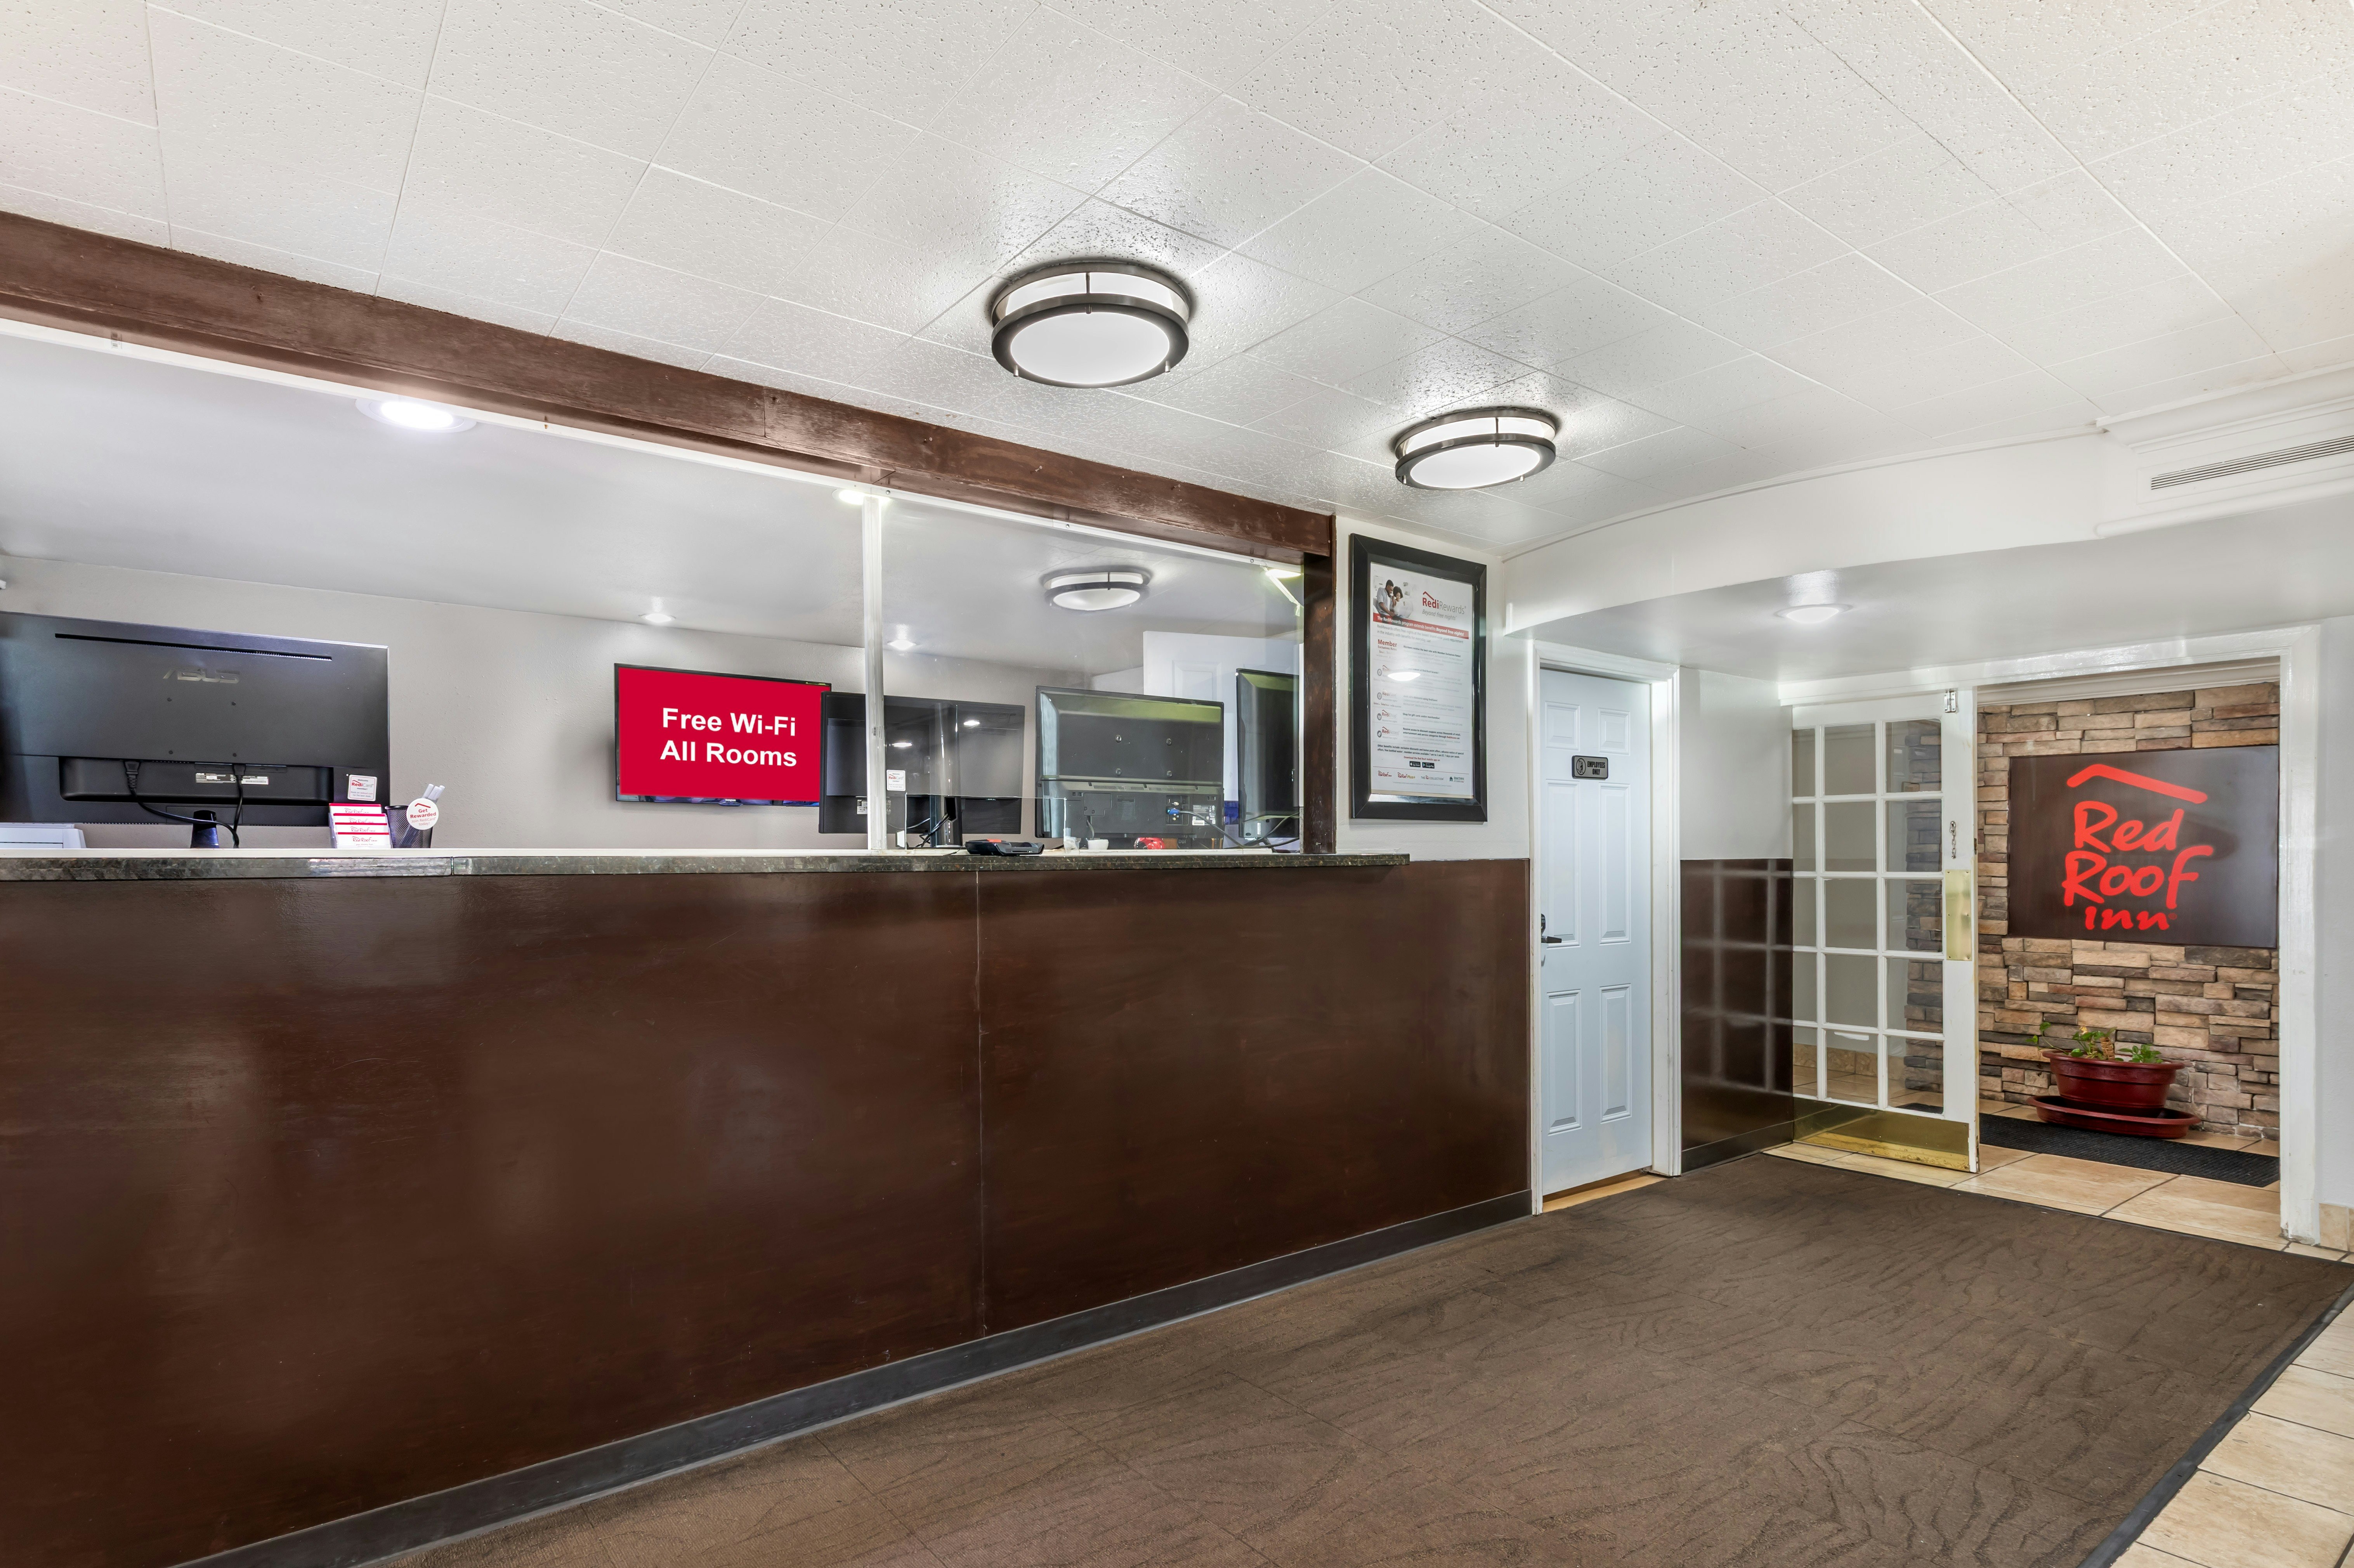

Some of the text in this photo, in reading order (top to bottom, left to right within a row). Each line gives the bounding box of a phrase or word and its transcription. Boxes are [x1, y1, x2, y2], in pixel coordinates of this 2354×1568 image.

[1378, 639, 1397, 647] Member
[163, 668, 241, 684] ASUS
[663, 708, 795, 736] Free Wi-Fi
[660, 740, 797, 767] All Rooms
[2074, 800, 2184, 853] Red
[2061, 850, 2213, 909] Roof
